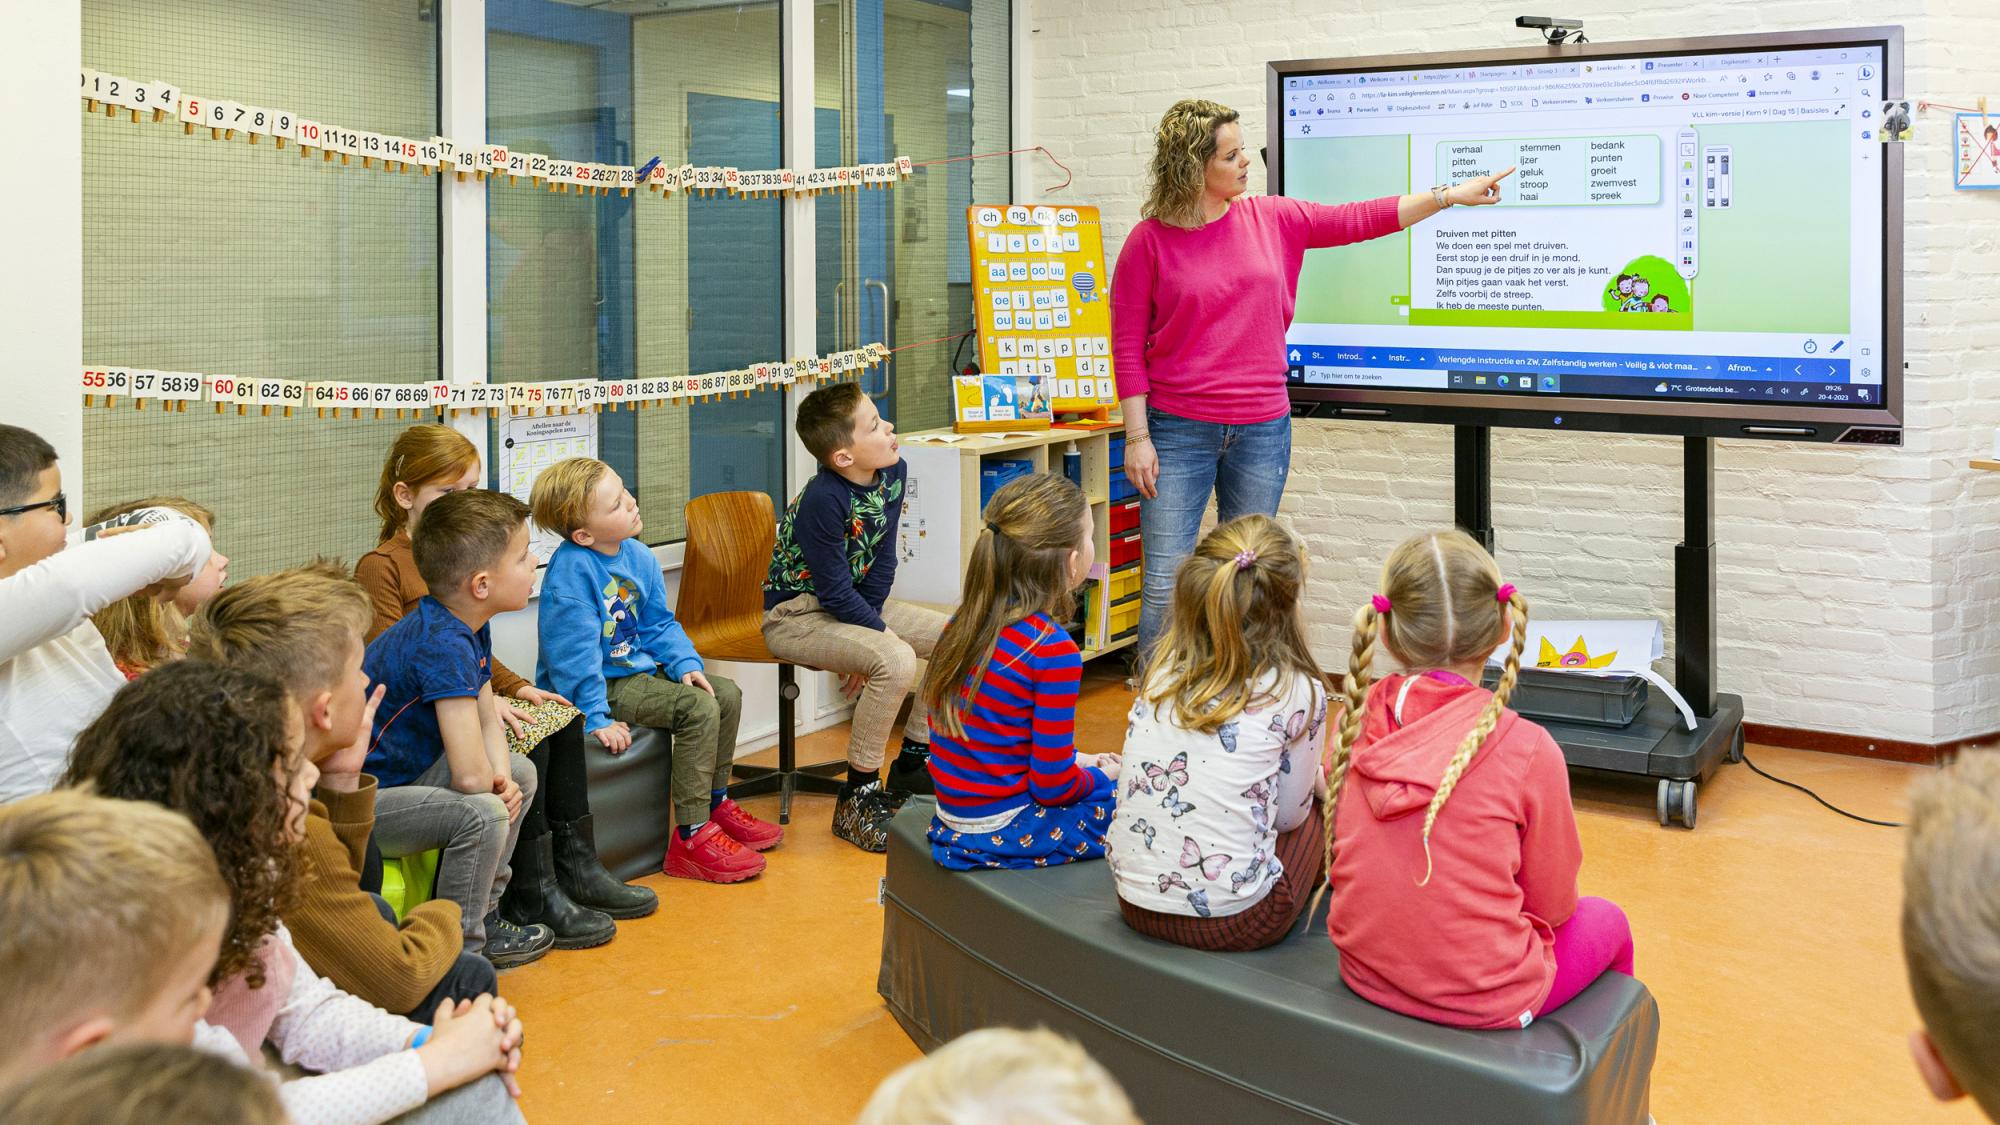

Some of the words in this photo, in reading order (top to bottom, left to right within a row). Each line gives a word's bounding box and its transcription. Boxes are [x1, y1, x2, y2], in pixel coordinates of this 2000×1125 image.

[94, 78, 100, 91] 1
[110, 82, 119, 96] 2
[135, 88, 145, 102] 3
[161, 90, 170, 103] 4
[189, 101, 198, 115] 5
[214, 106, 223, 120] 6
[235, 108, 245, 122] 7
[254, 112, 264, 126] 8
[280, 116, 289, 129] 9
[302, 125, 318, 139] 10
[324, 130, 338, 143] 11
[341, 134, 357, 148] 12
[363, 137, 378, 151] 13
[384, 140, 400, 154] 14
[402, 143, 416, 157] 15
[421, 146, 437, 159] 16
[439, 142, 453, 155] 17
[459, 153, 473, 165] 18
[493, 149, 506, 162] 20
[511, 157, 523, 169] 21
[532, 158, 546, 170] 22
[560, 165, 572, 176] 24
[576, 167, 590, 179] 25
[622, 170, 633, 181] 28
[653, 167, 665, 178] 30
[682, 169, 693, 181] 32
[726, 171, 737, 181] 35
[783, 173, 792, 183] 40
[851, 170, 860, 179] 46
[901, 159, 910, 168] 50
[1520, 144, 1560, 152] stemmen
[1591, 141, 1625, 149] bedank
[1452, 158, 1476, 167] pitten
[1520, 156, 1539, 165] ijzer
[1591, 155, 1623, 164] punten
[1452, 169, 1490, 177] schatkist
[1520, 168, 1544, 178] geluk
[1591, 166, 1616, 176] groeit
[1520, 180, 1548, 190] stroop
[1591, 179, 1637, 187] zwemvest
[1591, 191, 1622, 201] spreek
[983, 212, 997, 222] ch
[1012, 210, 1026, 222] ng
[1059, 212, 1077, 222] sch
[1436, 230, 1469, 238] Druiven
[1472, 230, 1489, 238] met
[1491, 230, 1516, 240] pitten
[1032, 238, 1039, 246] o
[1068, 238, 1075, 246] u
[1494, 242, 1512, 251] spel
[1534, 242, 1568, 250] druiven.
[1436, 254, 1457, 262] Eerst
[1460, 254, 1479, 263] stop
[1510, 254, 1529, 262] druif
[1552, 254, 1581, 262] mond.
[992, 268, 1005, 277] aa
[1012, 267, 1026, 276] ee
[1032, 267, 1045, 275] oo
[1051, 267, 1064, 276] uu
[1436, 266, 1453, 274] Dan
[1507, 267, 1531, 275] pitjes
[1436, 278, 1454, 287] Mijn
[1456, 278, 1479, 288] pitjes
[1505, 278, 1525, 286] vaak
[1544, 279, 1568, 287] verst.
[995, 296, 1008, 304] oe
[1018, 295, 1025, 306] ij
[1036, 296, 1049, 304] eu
[1055, 293, 1064, 302] ie
[1436, 290, 1456, 298] Zelfs
[1459, 290, 1488, 299] voorbij
[1504, 291, 1533, 300] streep.
[996, 316, 1010, 325] ou
[1018, 316, 1031, 325] au
[1040, 315, 1049, 324] ui
[1058, 313, 1067, 322] ei
[1005, 342, 1012, 352] k
[1024, 344, 1033, 352] m
[1044, 345, 1050, 353] s
[1062, 343, 1068, 354] p
[1045, 363, 1051, 372] b
[1082, 362, 1088, 371] d
[1439, 356, 1475, 365] Verlengde
[1478, 356, 1513, 364] instructie
[1527, 358, 1540, 366] ZW,
[1542, 359, 1586, 368] Zelfstandig
[1625, 362, 1647, 370] Veilig
[83, 372, 105, 387] 55
[135, 376, 154, 390] 57
[162, 378, 181, 391] 58
[215, 380, 233, 394] 60
[237, 383, 253, 397] 61
[262, 384, 280, 397] 62
[284, 385, 301, 399] 63
[316, 387, 334, 400] 64
[352, 388, 368, 400] 66
[375, 388, 390, 401] 67
[433, 385, 448, 398] 70
[452, 390, 465, 401] 71
[472, 389, 486, 400] 72
[490, 389, 504, 400] 73
[510, 387, 524, 398] 74
[528, 390, 541, 401] 75
[611, 385, 623, 396] 80
[642, 383, 654, 393] 82
[687, 380, 698, 390] 85
[715, 377, 725, 387] 87
[757, 367, 766, 378] 90
[844, 355, 853, 364] 97
[1320, 373, 1330, 381] Typ
[1084, 384, 1090, 394] g
[1686, 385, 1722, 393] Grotendeels
[532, 422, 551, 430] Aftellen
[526, 428, 563, 437] Koningsspelen
